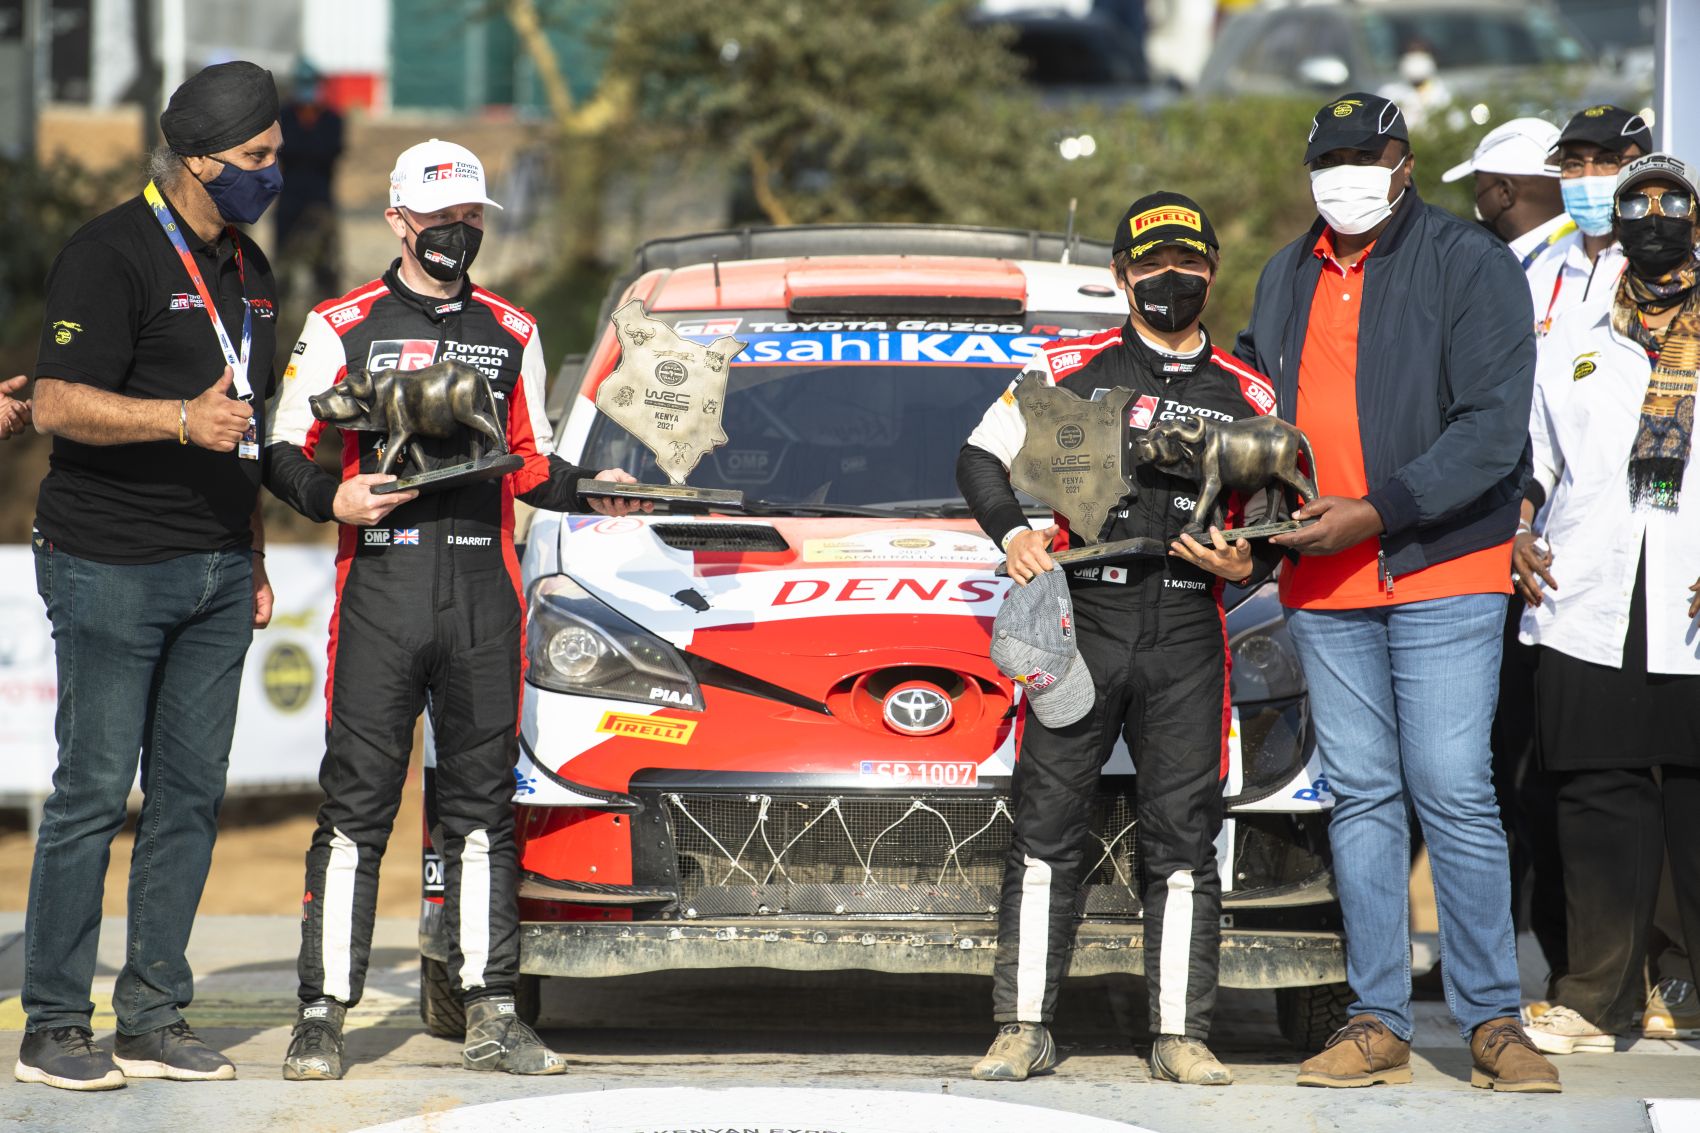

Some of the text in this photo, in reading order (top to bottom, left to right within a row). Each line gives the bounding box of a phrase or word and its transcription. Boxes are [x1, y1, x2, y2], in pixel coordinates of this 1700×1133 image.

[423, 170, 452, 182] GR
[1135, 208, 1197, 231] PIRELLI
[331, 308, 362, 325] OMP
[502, 315, 530, 335] OMP
[748, 321, 887, 332] TOYOTA
[896, 321, 1023, 333] GAZOO
[445, 340, 509, 358] TOYOTA
[736, 333, 889, 361] sahi
[369, 353, 432, 371] GR
[1051, 352, 1082, 370] OMP
[645, 388, 690, 404] WRC
[1247, 383, 1275, 409] OMP
[654, 411, 679, 423] KENYA
[1163, 400, 1234, 423] TOYOTA
[656, 422, 674, 430] 2021
[1051, 455, 1090, 465] WRC
[1065, 485, 1080, 493] 2021
[364, 531, 390, 543] OMP
[456, 536, 491, 546] BARRITT
[771, 578, 1007, 606] DENS
[1172, 580, 1206, 590] KATSUTA
[649, 687, 693, 706] PIAA
[603, 715, 688, 739] PIRELLI
[917, 763, 973, 785] 1007
